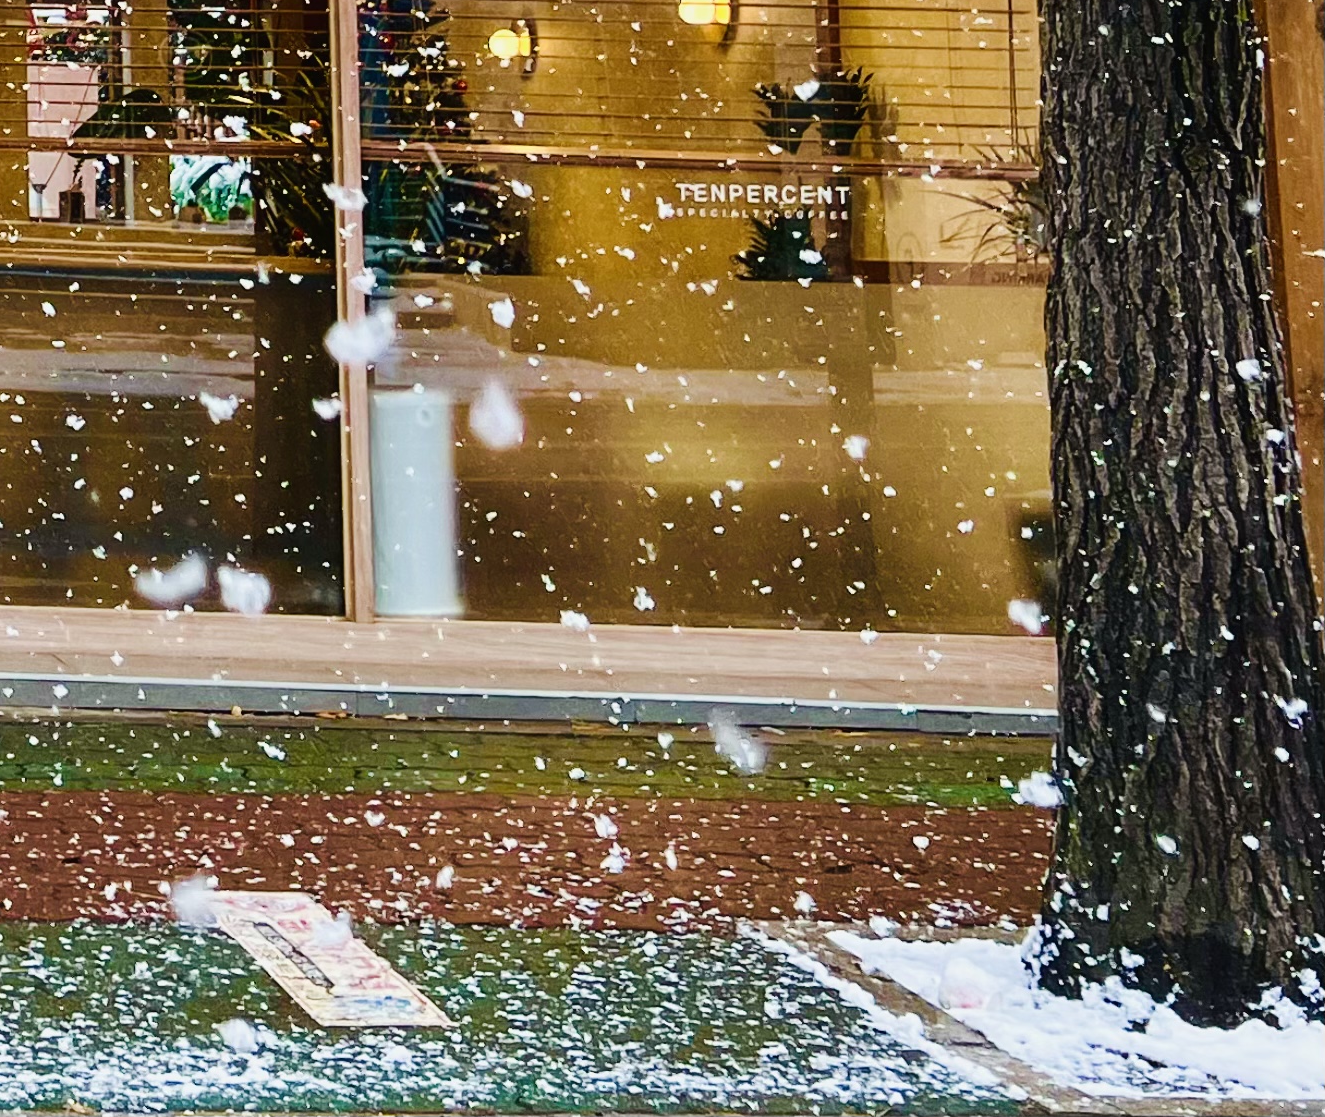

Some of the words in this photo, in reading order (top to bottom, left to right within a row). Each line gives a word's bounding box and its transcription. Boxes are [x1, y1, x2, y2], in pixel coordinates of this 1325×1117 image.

[674, 182, 850, 205] TENPERCENT
[676, 207, 773, 220] SPECIALTY
[784, 208, 849, 221] COFFEE
